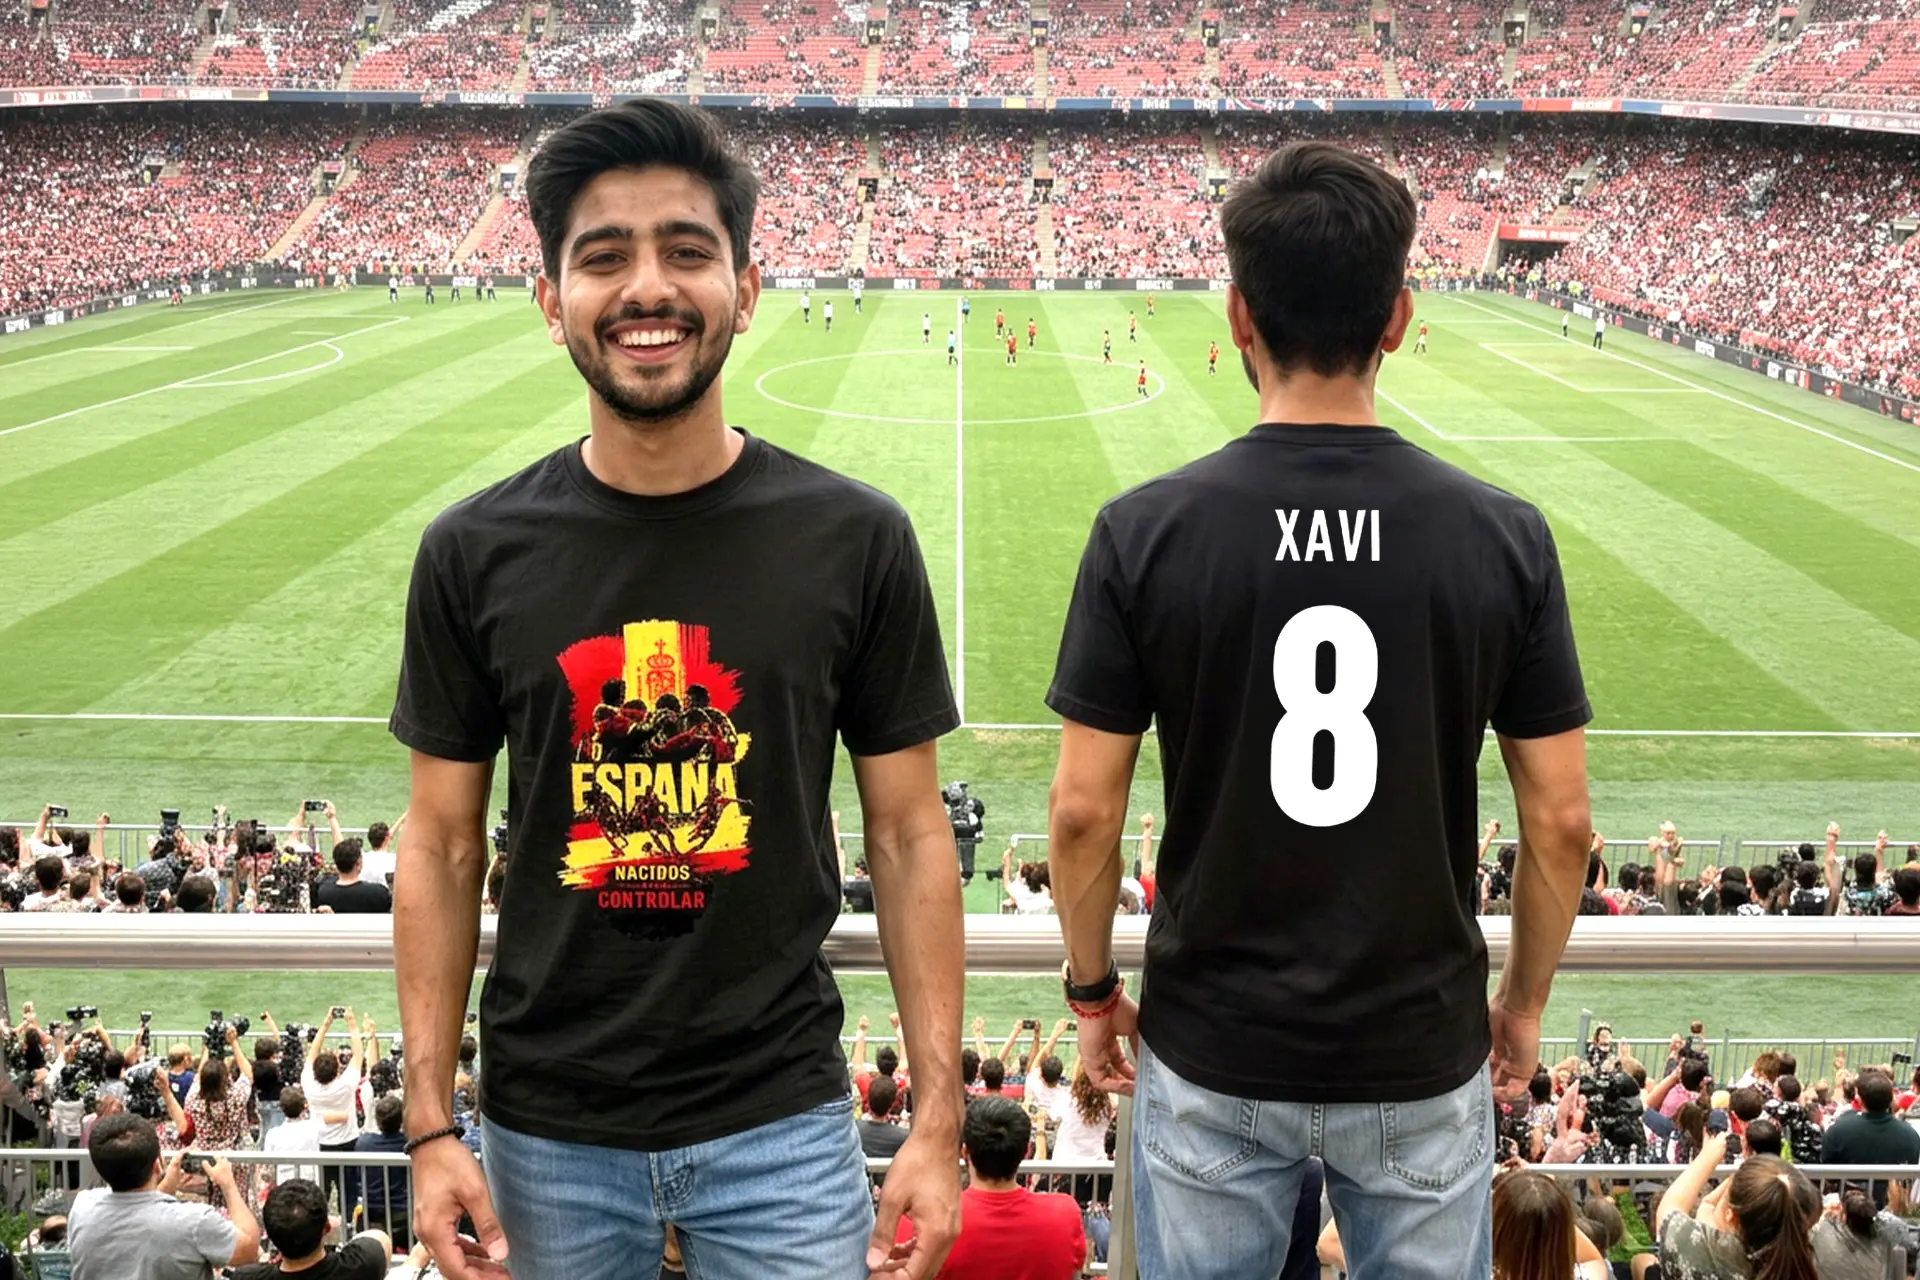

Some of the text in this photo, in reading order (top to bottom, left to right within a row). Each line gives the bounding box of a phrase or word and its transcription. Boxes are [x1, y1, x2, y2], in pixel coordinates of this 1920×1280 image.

[1275, 509, 1380, 562] XAVI
[1270, 605, 1378, 827] 8
[615, 865, 690, 881] NACIDOS
[598, 890, 705, 909] CONTROLAR
